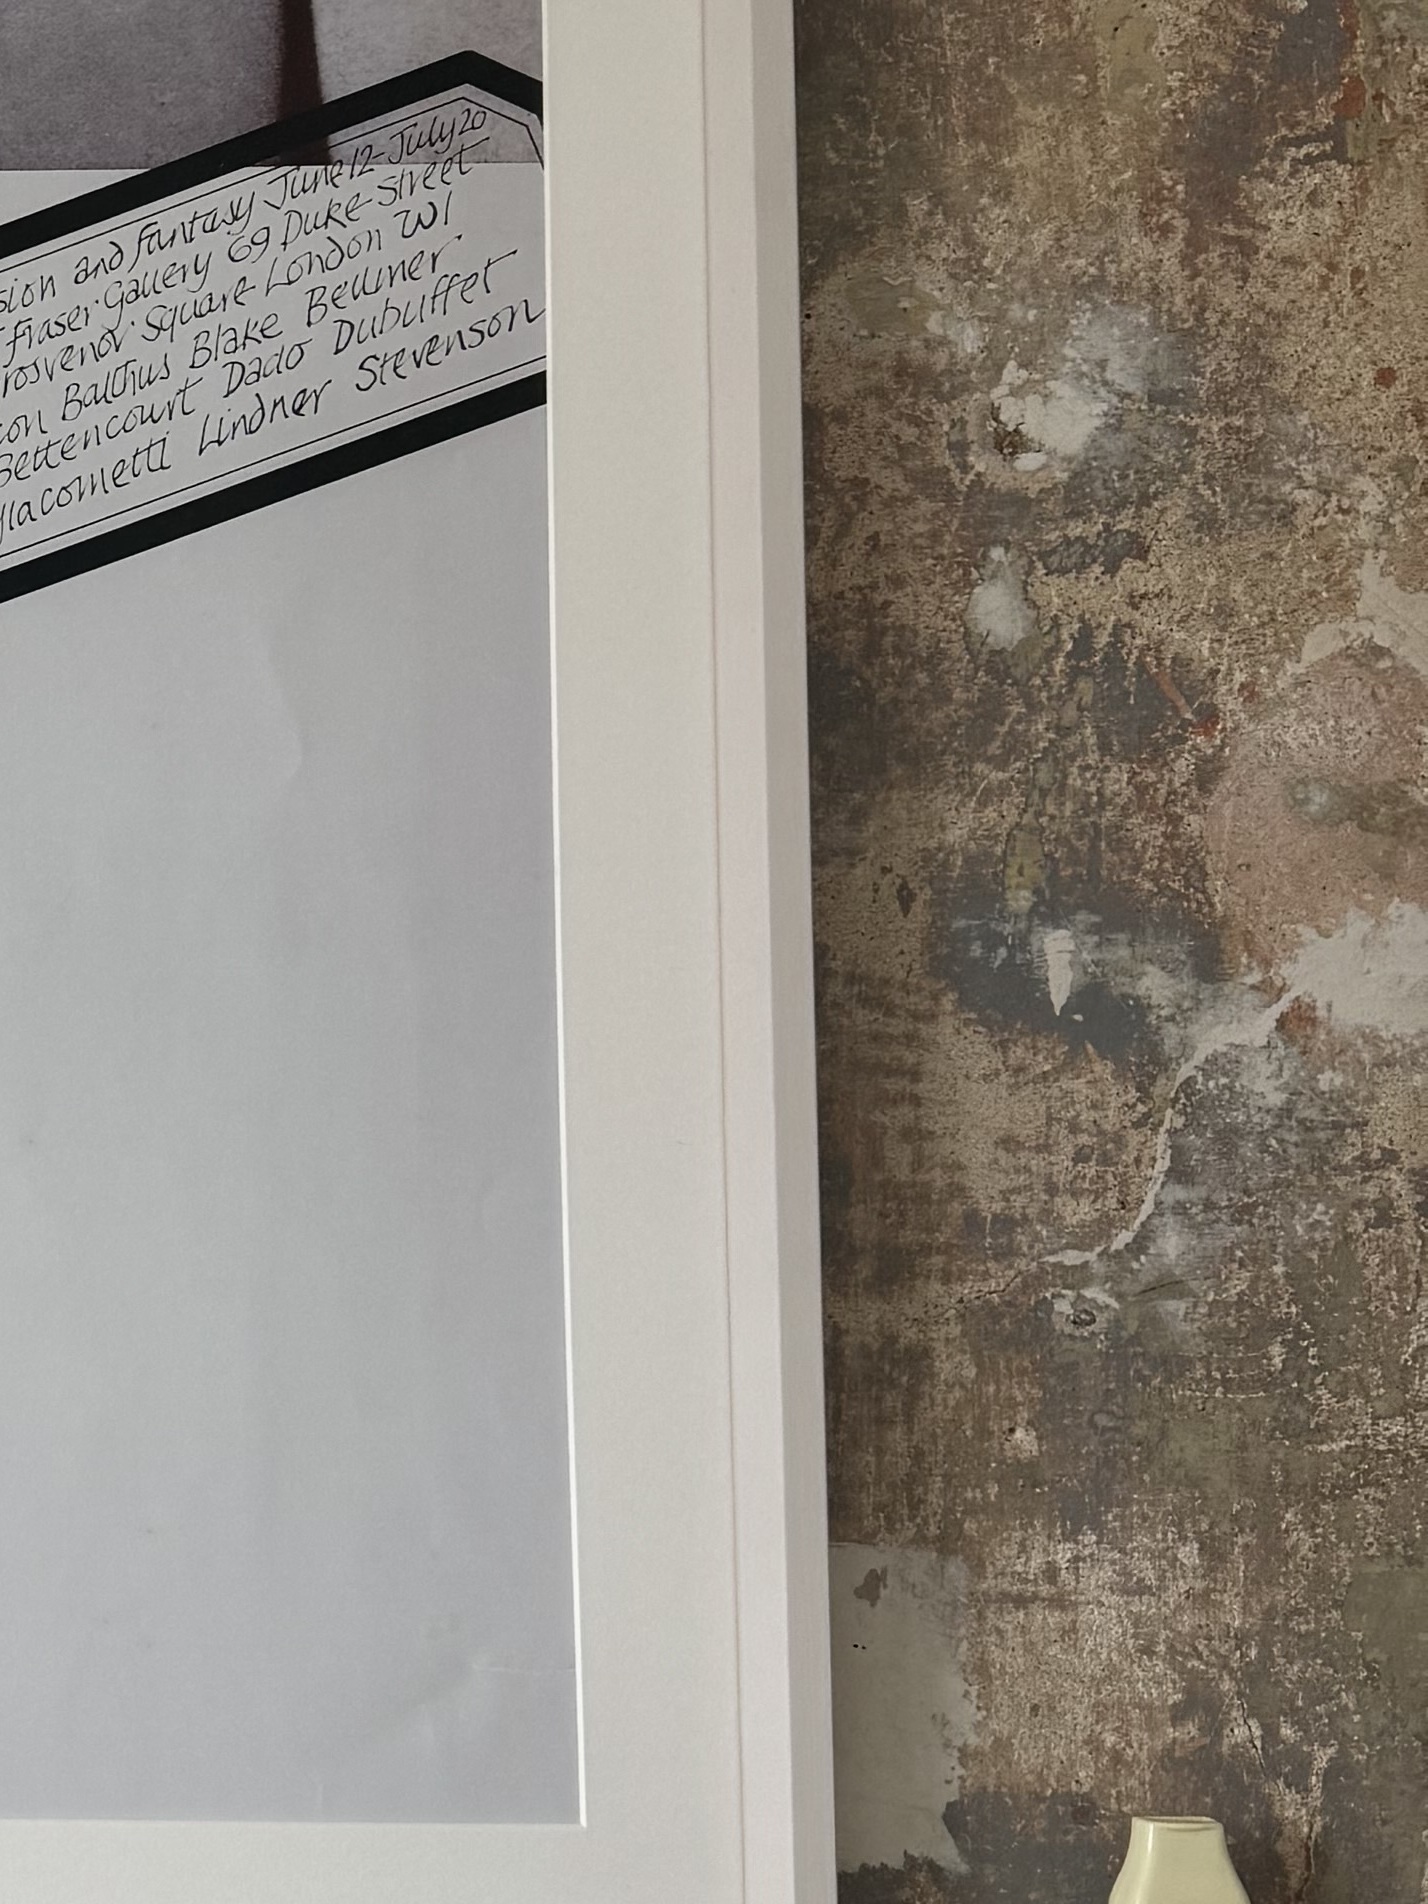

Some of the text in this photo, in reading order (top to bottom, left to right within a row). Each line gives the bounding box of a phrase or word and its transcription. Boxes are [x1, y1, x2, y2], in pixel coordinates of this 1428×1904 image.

[74, 241, 124, 285] and
[263, 159, 343, 210] June
[228, 227, 271, 264] 69
[282, 192, 372, 251] Duke
[265, 228, 382, 297] London
[61, 352, 171, 422] Balthus
[189, 312, 284, 369] Blake
[199, 379, 332, 457] Lindner
[355, 298, 546, 392] Stevenson
[222, 338, 313, 398] Dado
[333, 248, 518, 356] Dubuffet
